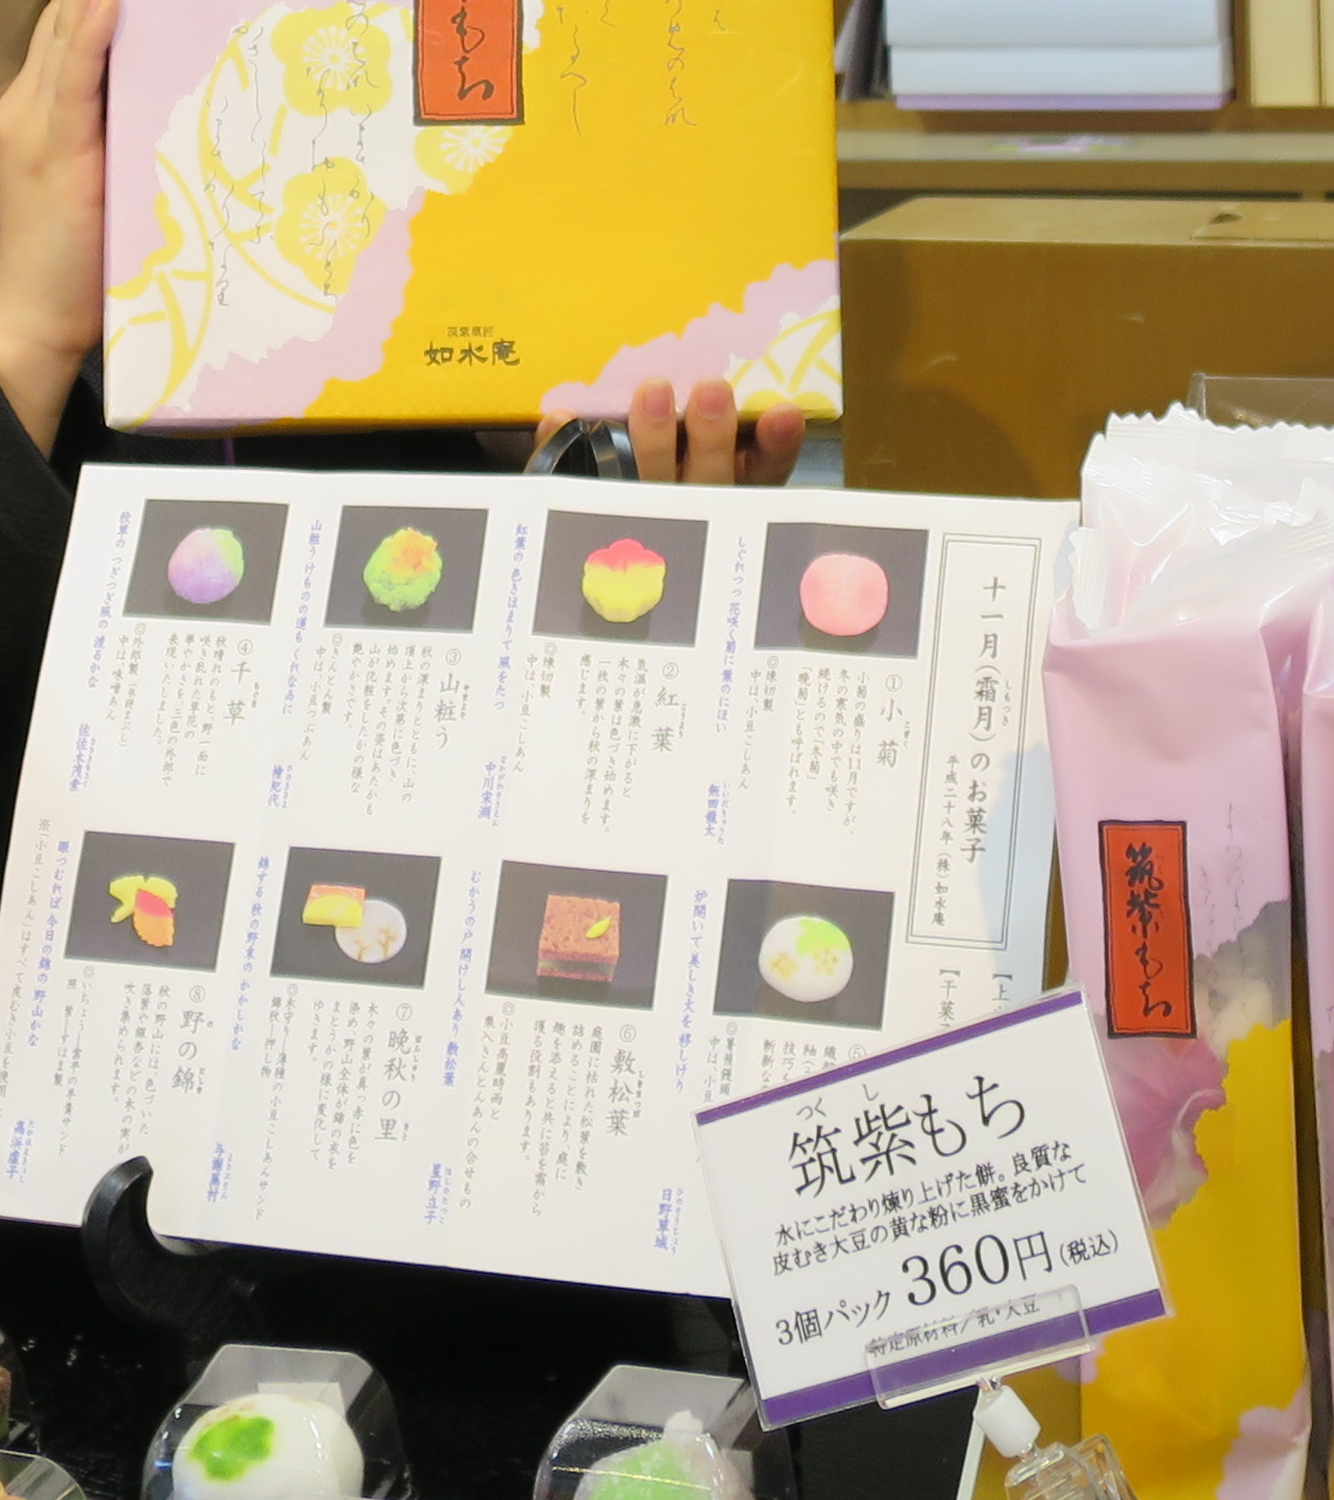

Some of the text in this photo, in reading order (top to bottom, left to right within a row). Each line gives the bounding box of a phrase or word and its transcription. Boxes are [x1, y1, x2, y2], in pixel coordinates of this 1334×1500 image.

[423, 338, 520, 367] 如水庵
[1123, 842, 1173, 1020] 筑紫もち
[788, 1074, 1026, 1198] 筑紫もち
[796, 1097, 828, 1121] つく
[771, 1162, 1088, 1277] 皮むき大豆の黄な粉に黒蜜をかけて
[775, 1288, 893, 1347] 3個パック
